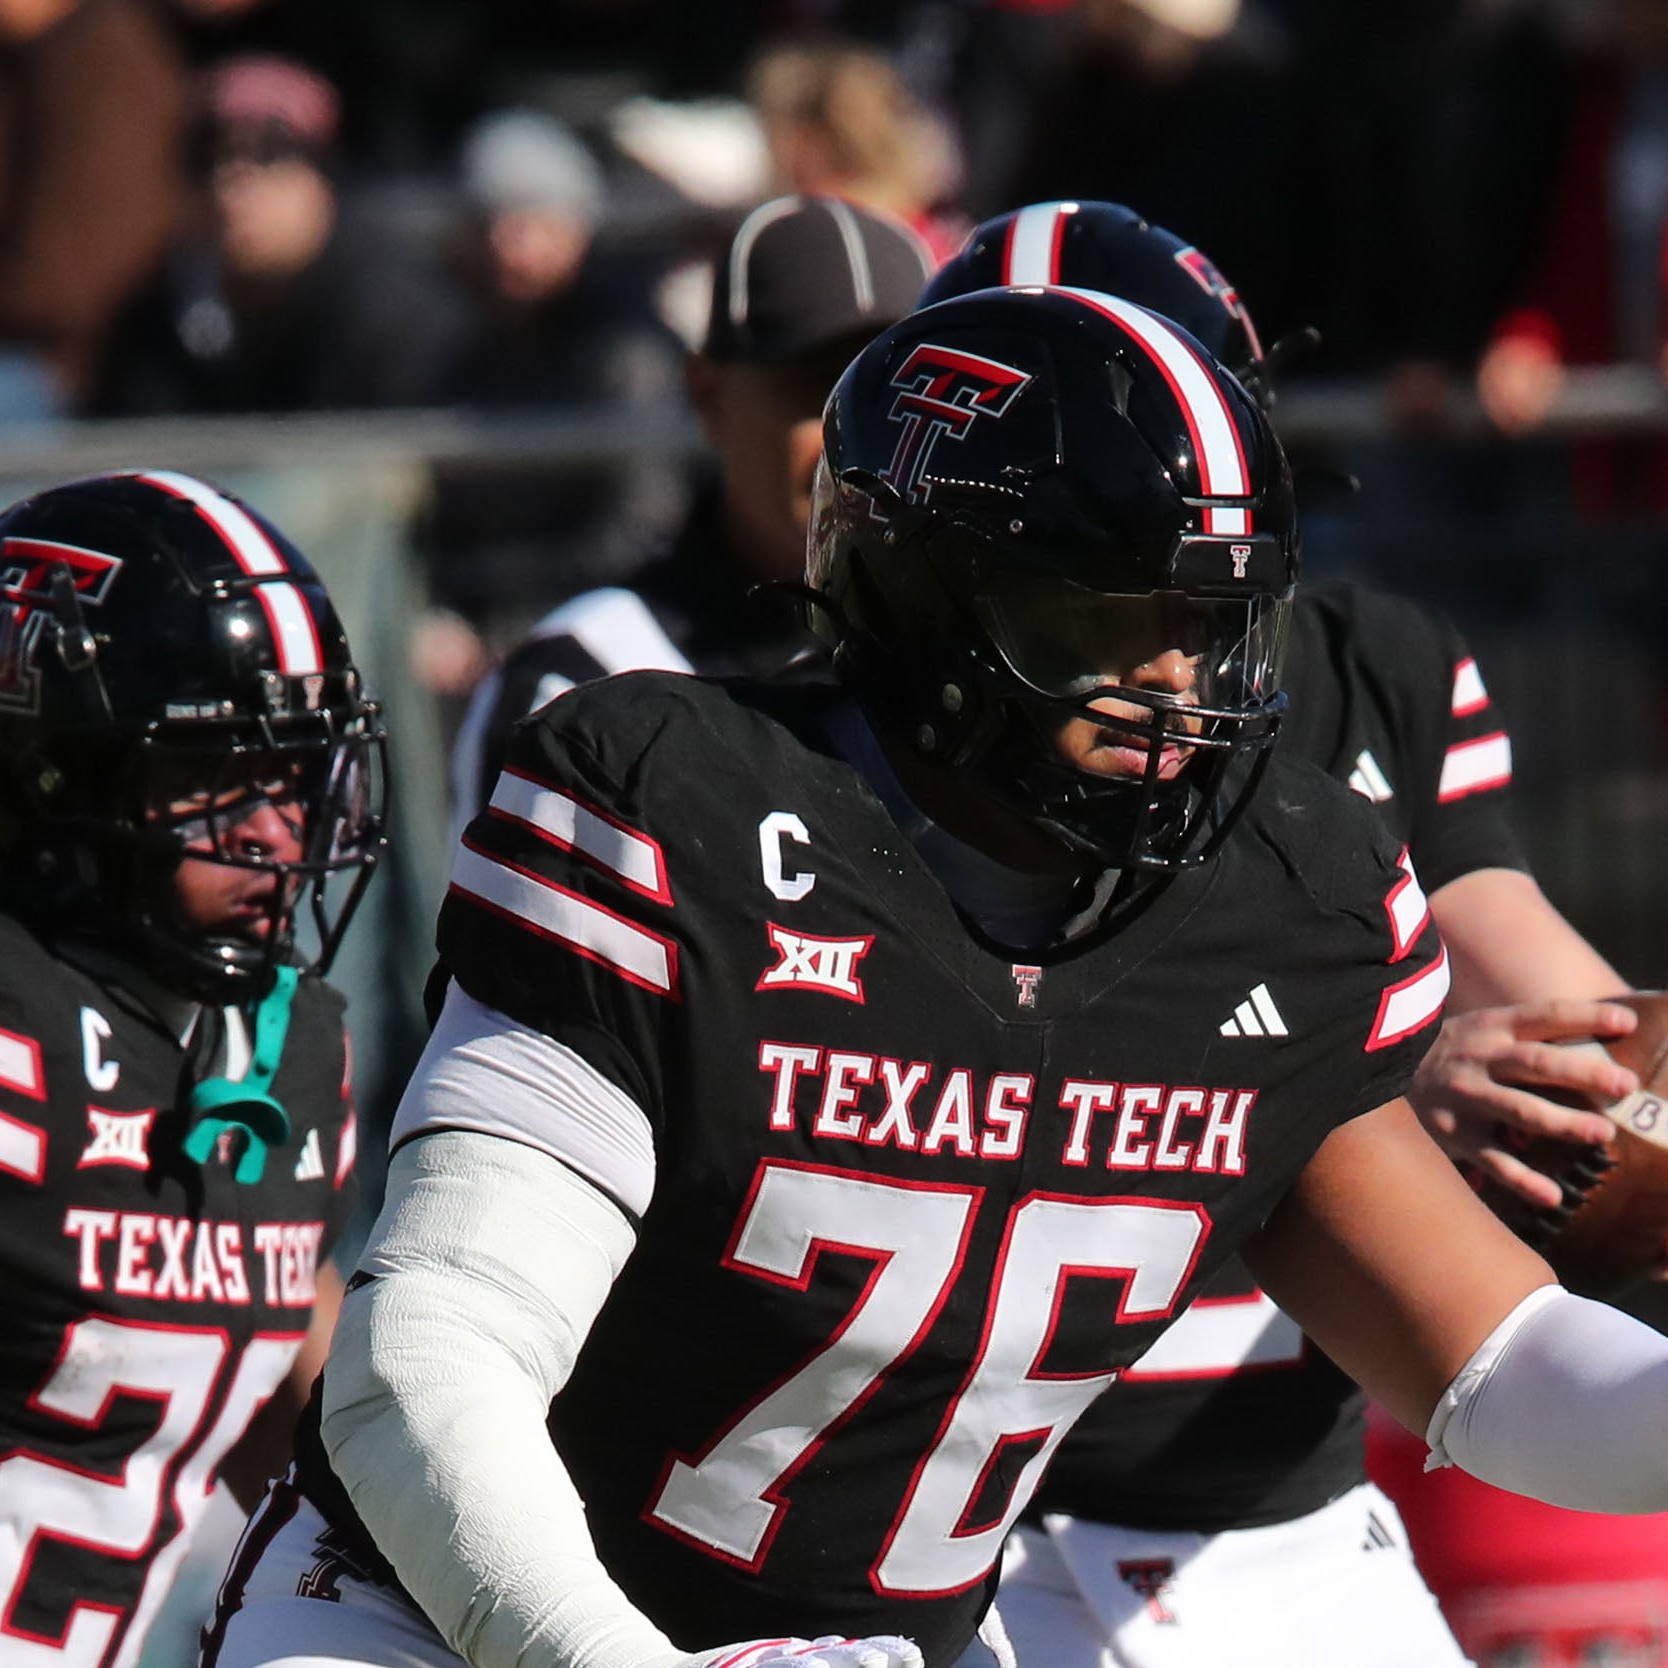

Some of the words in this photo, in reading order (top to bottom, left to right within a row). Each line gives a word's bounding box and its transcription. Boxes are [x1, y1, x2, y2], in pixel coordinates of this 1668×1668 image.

[759, 811, 816, 901] C
[81, 1006, 120, 1091] C
[758, 1039, 1035, 1160] TEXAS
[1059, 1076, 1259, 1177] TECH
[63, 1205, 251, 1305] TEXAS
[642, 1156, 1213, 1599] 76
